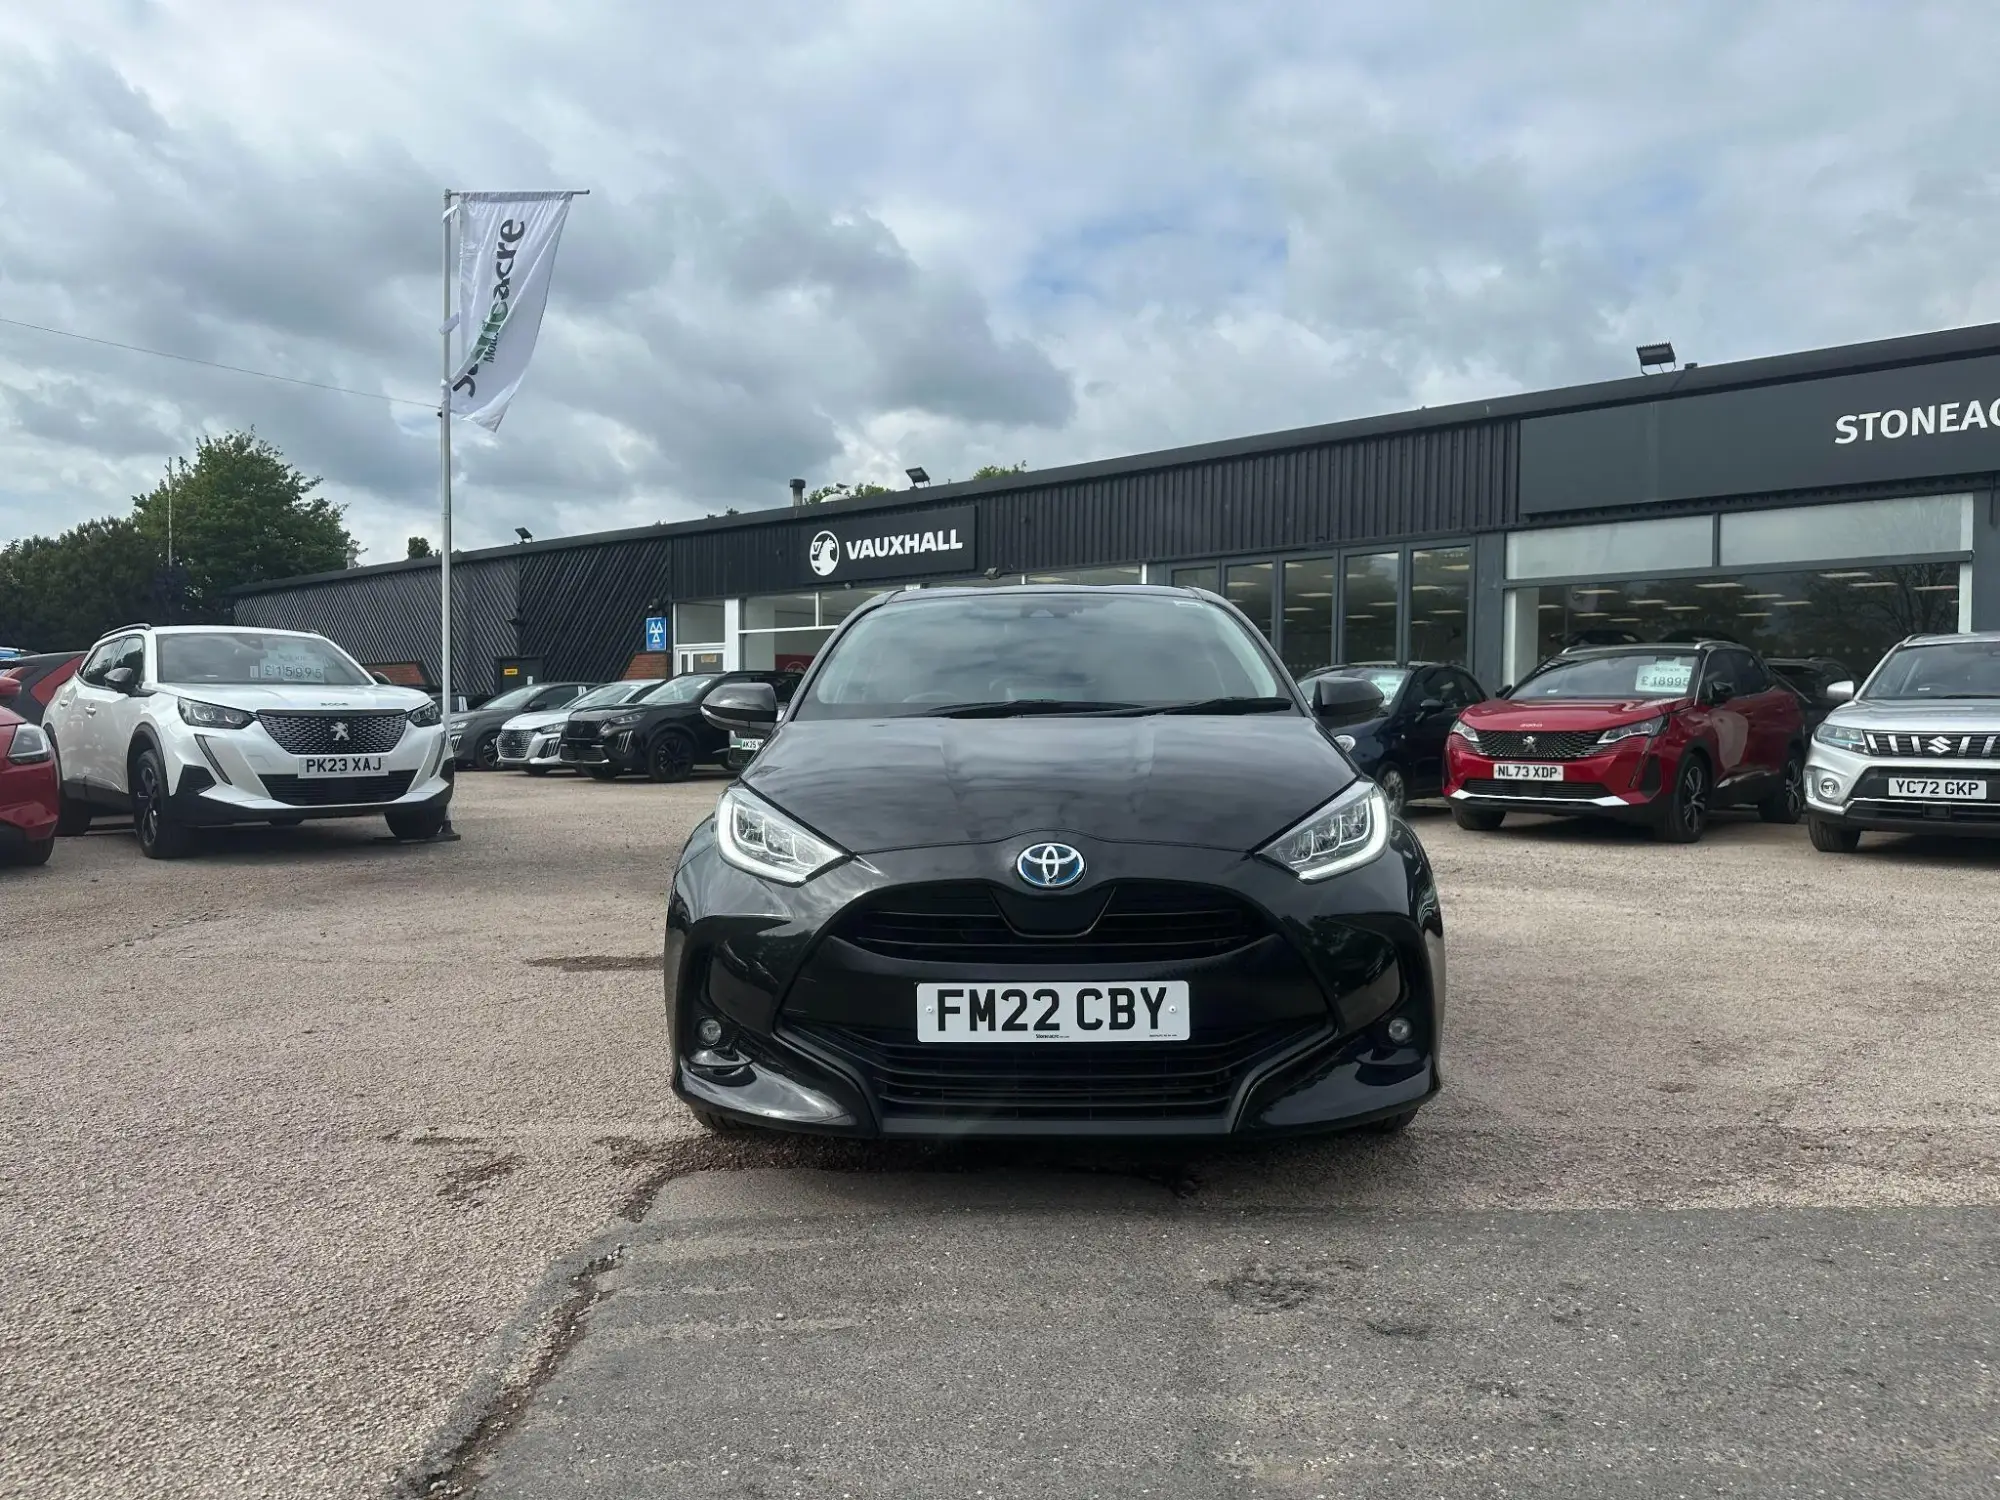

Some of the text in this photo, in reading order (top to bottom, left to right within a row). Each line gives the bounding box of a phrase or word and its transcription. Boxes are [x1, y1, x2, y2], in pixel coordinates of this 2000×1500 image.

[452, 218, 525, 397] Sneacre
[482, 333, 499, 363] Mot
[846, 529, 963, 560] VAUXHALL
[306, 757, 382, 773] PK23 XAJ
[1498, 765, 1557, 778] NL73 XDP
[1896, 780, 1979, 795] YC72 GKP
[937, 987, 1167, 1031] FM22 CBY
